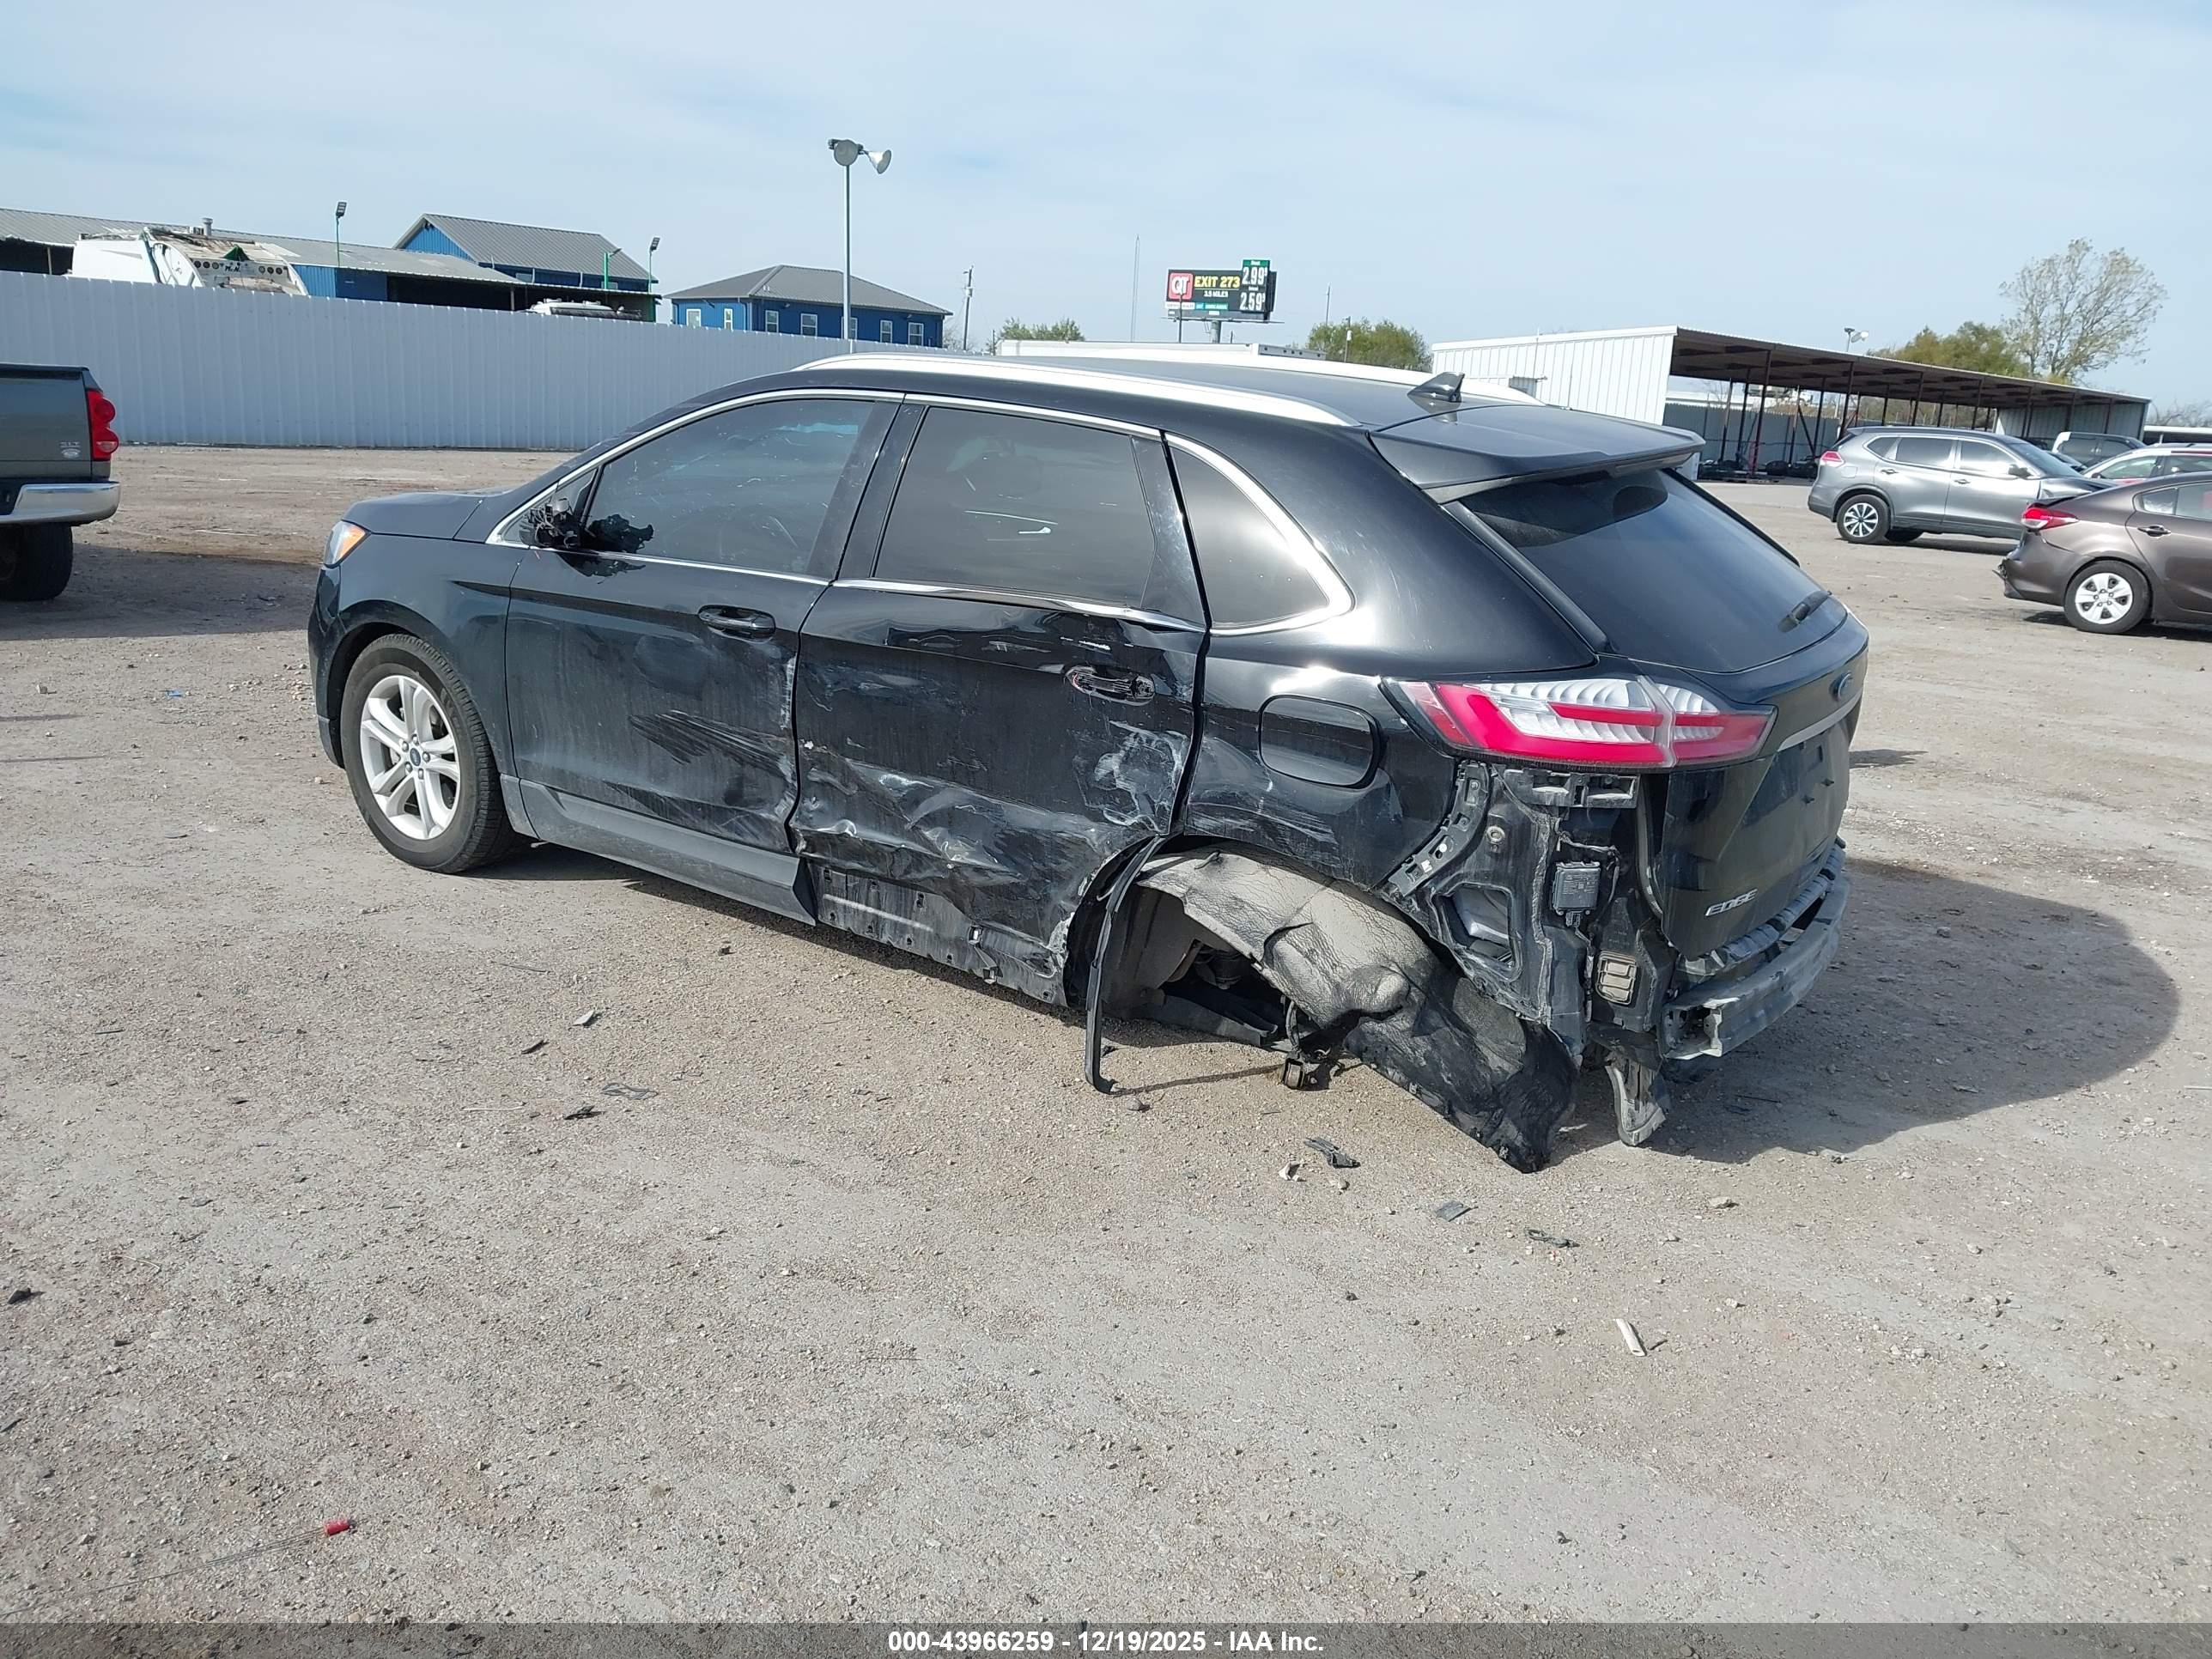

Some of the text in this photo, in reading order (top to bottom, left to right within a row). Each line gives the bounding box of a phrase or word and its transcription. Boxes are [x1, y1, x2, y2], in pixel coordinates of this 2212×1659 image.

[1171, 276, 1189, 295] QT
[1194, 276, 1218, 288] EXIT
[1219, 276, 1241, 289] 273
[1705, 888, 1758, 916] EDGE
